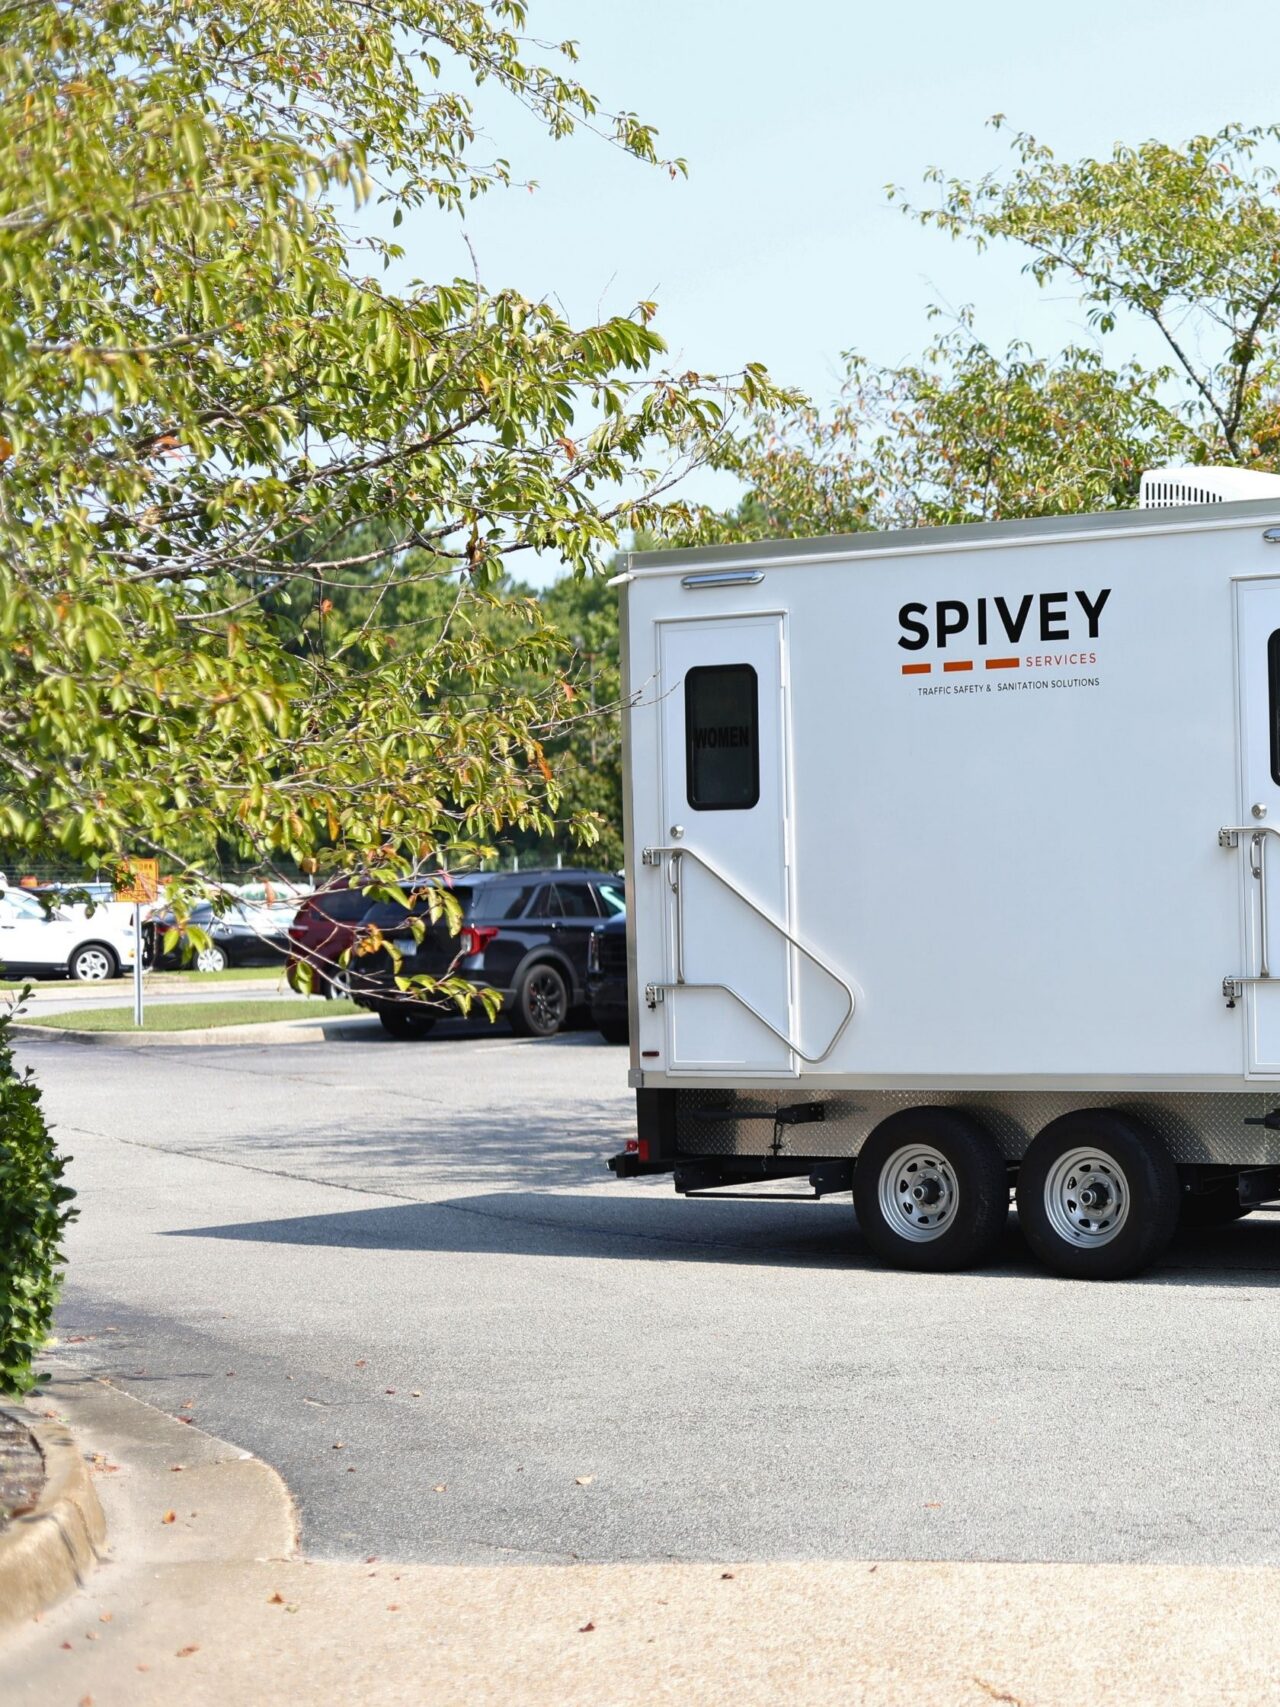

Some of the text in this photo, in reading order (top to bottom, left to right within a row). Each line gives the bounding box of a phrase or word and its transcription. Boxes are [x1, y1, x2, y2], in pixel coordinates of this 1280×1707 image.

[898, 589, 1111, 650] SPIVEY
[1026, 652, 1097, 667] SERVICES
[918, 678, 1100, 696] TRAFFIC SAFETY & SANITATION SOLUTIONS
[694, 726, 749, 749] WOMEN
